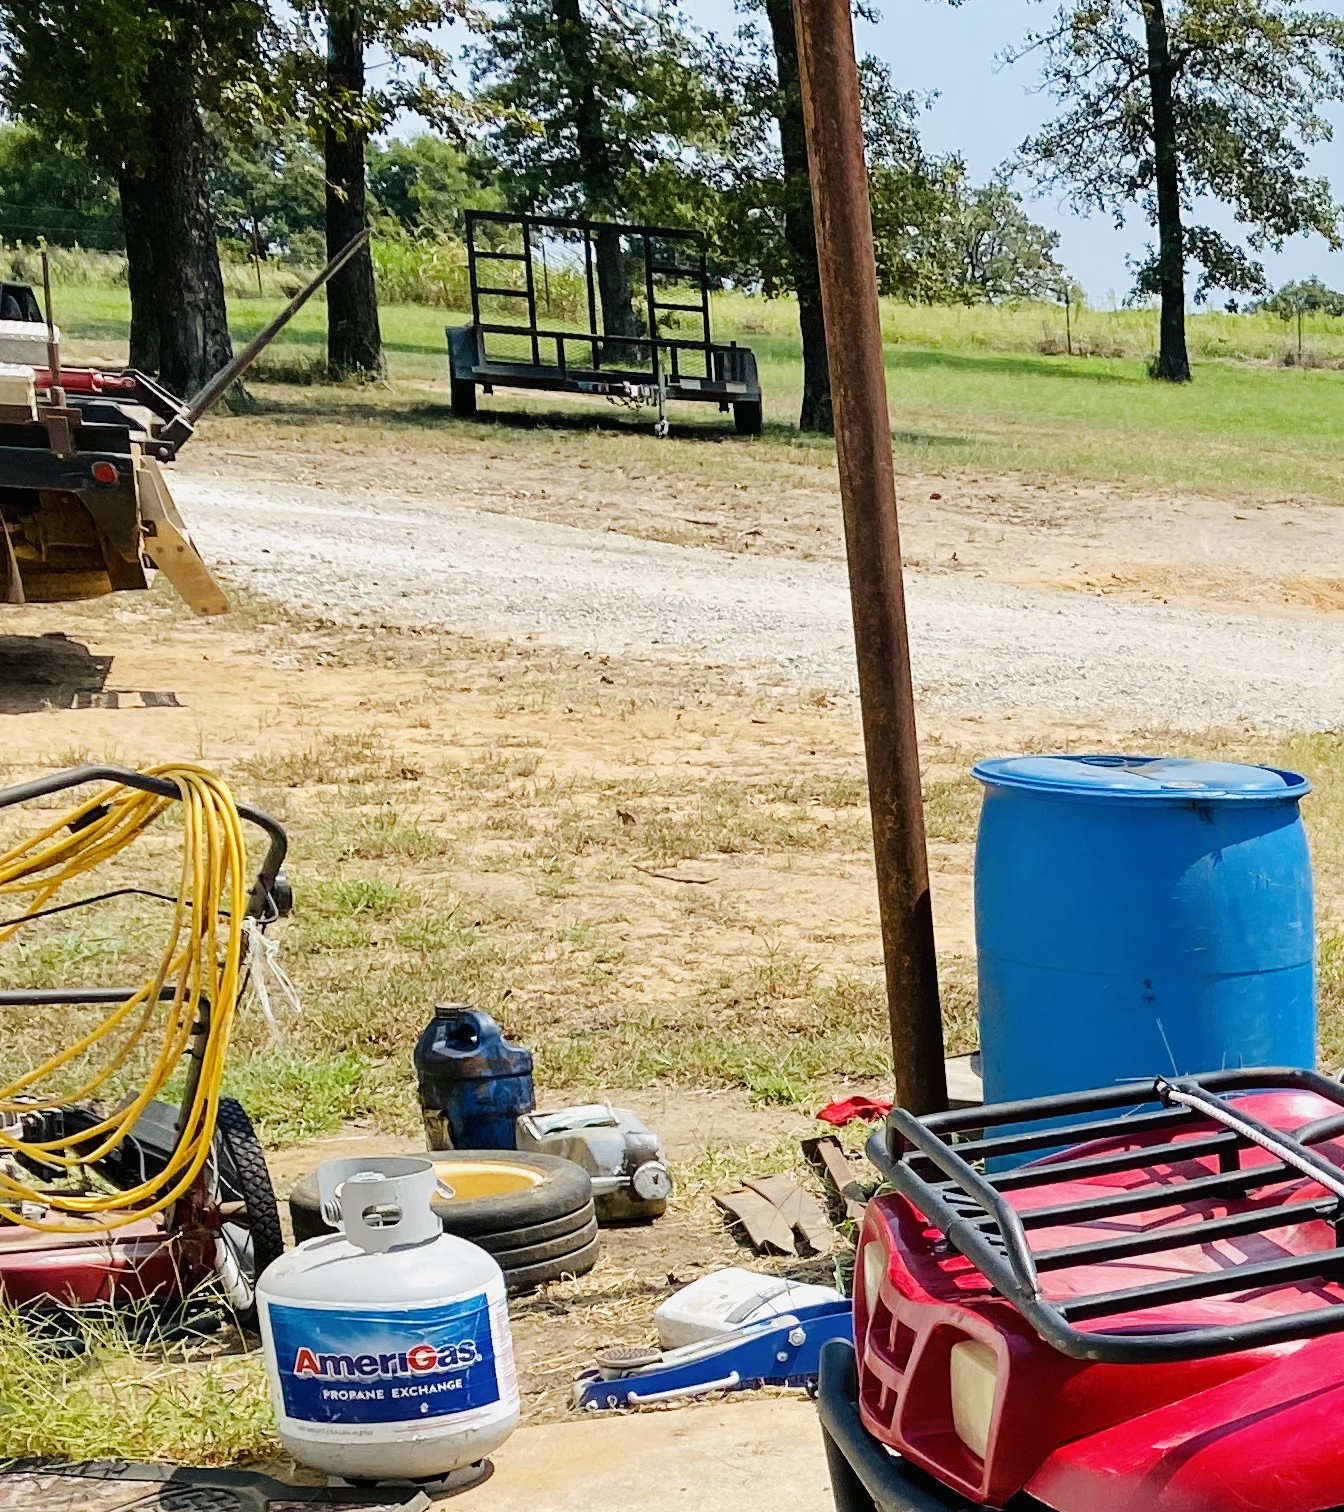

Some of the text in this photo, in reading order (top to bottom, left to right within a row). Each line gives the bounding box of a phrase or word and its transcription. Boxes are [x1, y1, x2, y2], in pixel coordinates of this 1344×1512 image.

[293, 1339, 478, 1382] AmeriGas
[322, 1378, 463, 1401] PROPANE EXCHANGE
